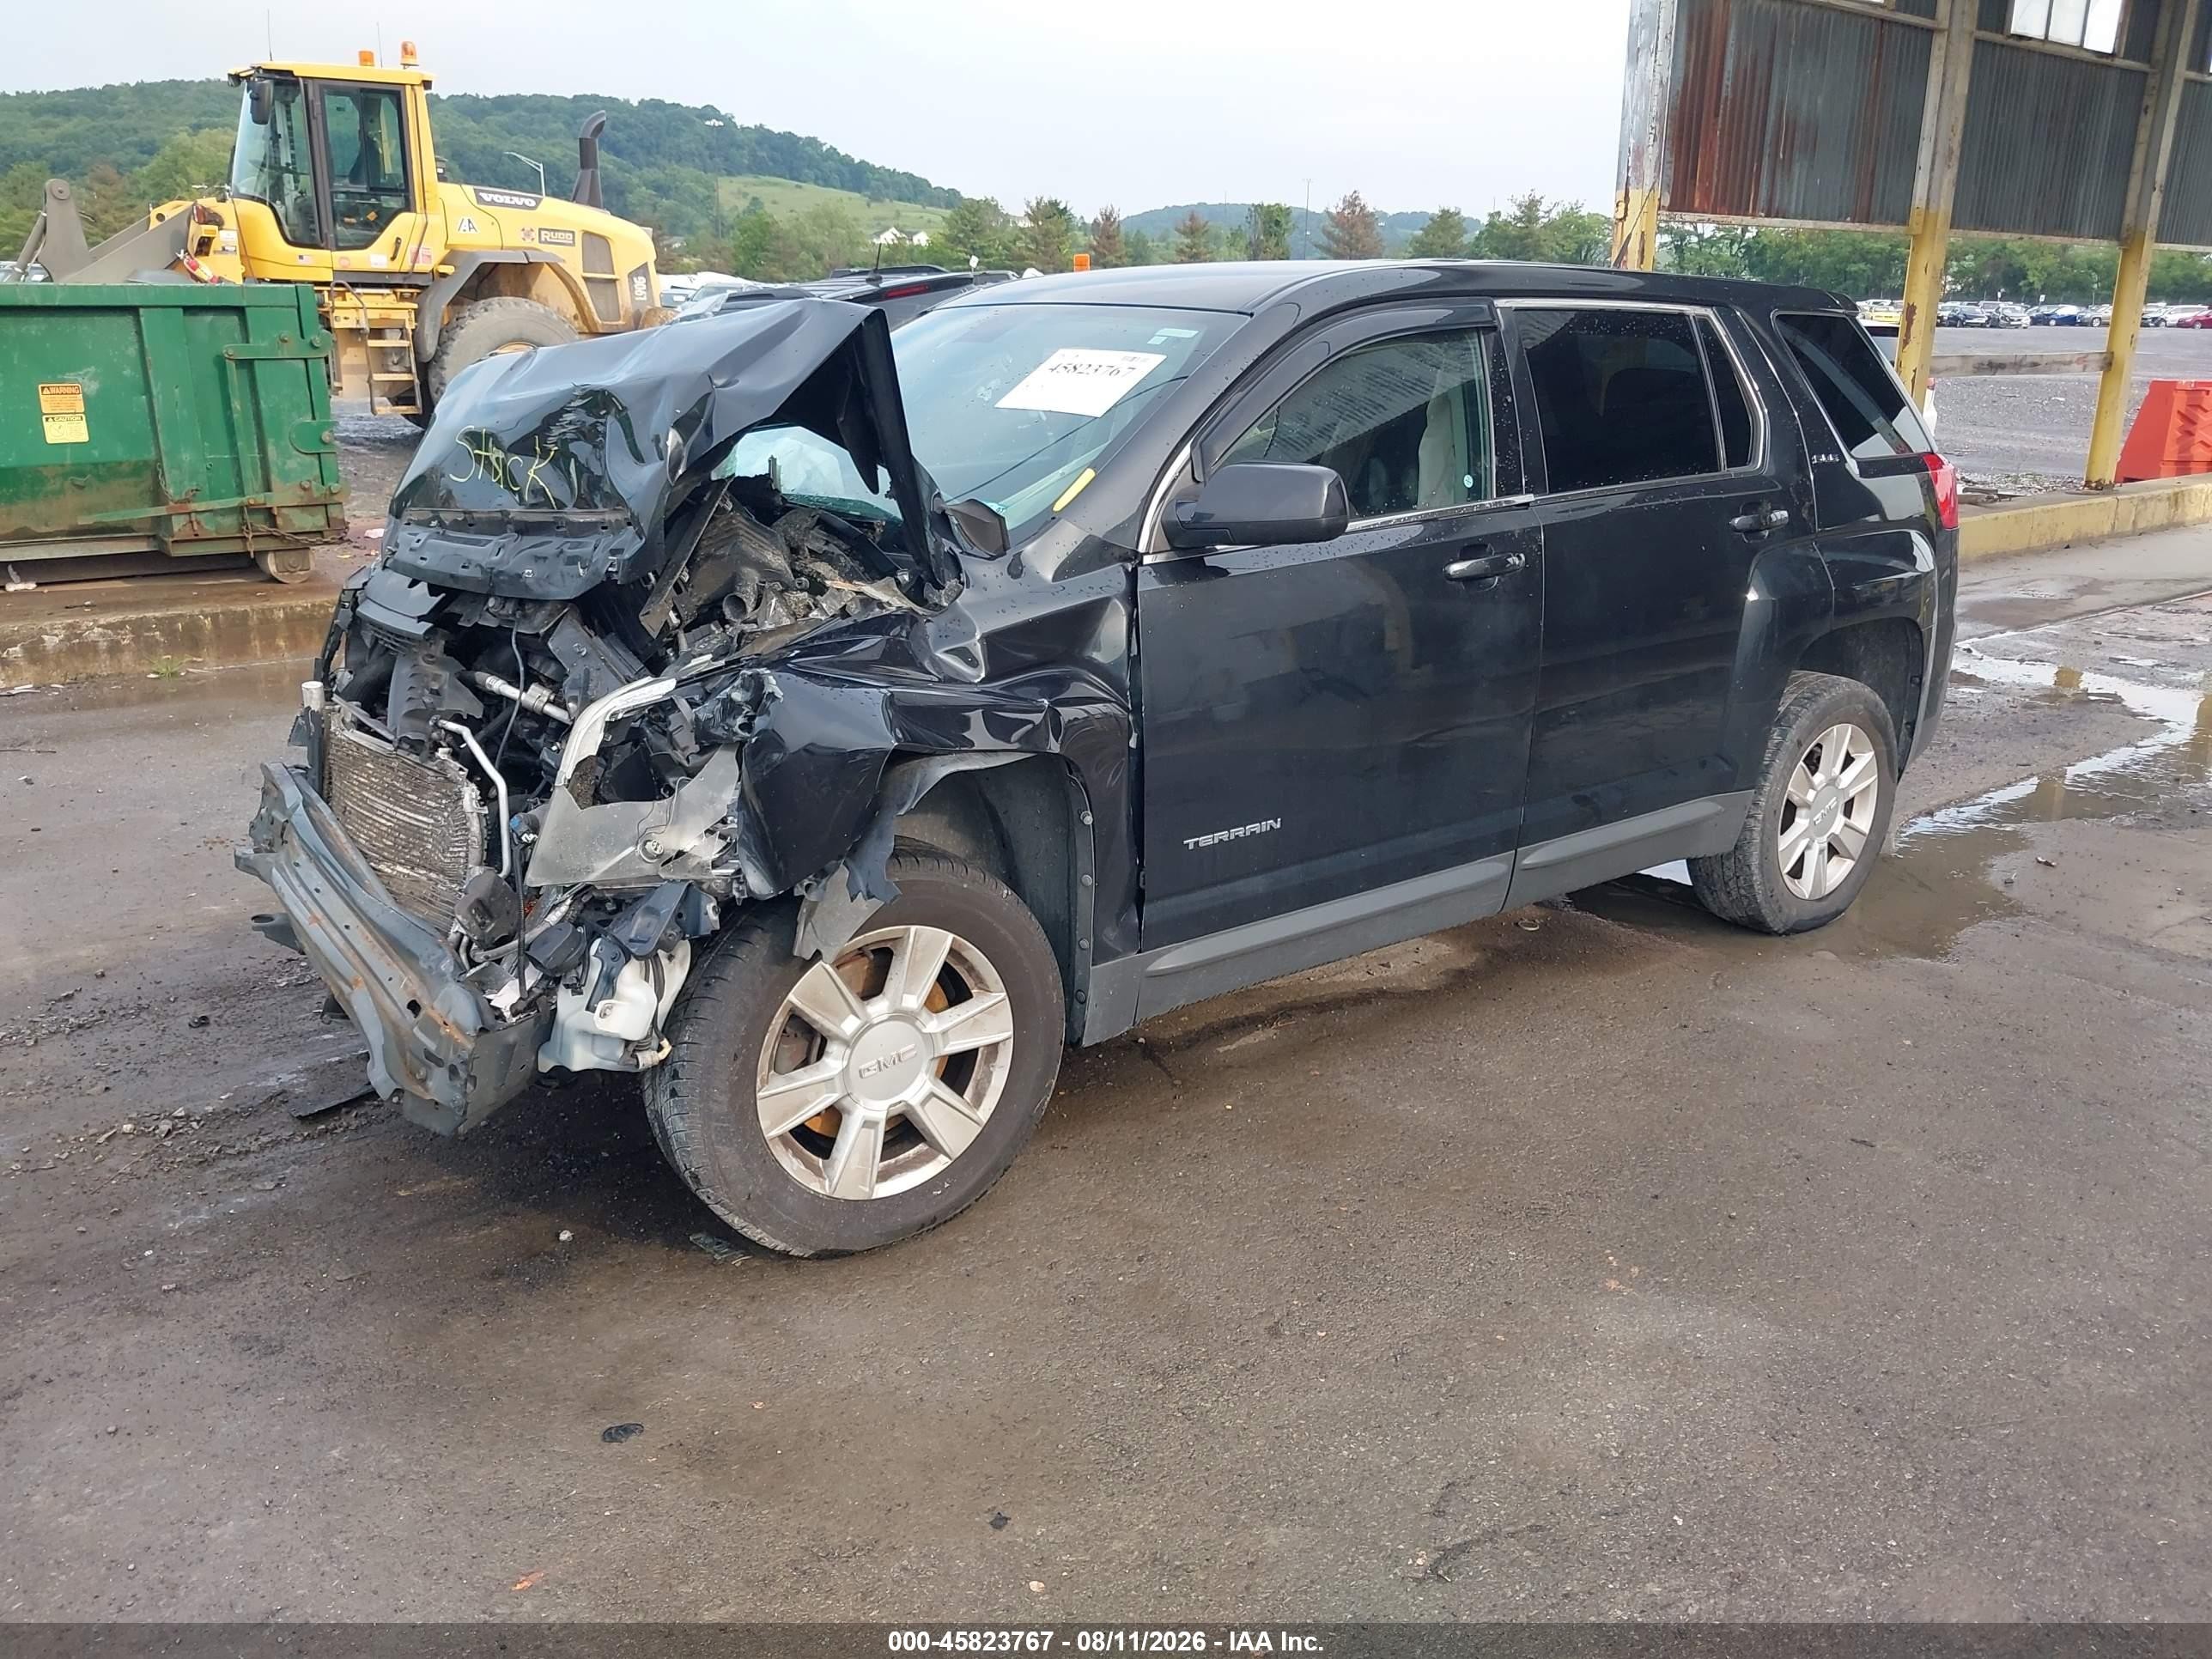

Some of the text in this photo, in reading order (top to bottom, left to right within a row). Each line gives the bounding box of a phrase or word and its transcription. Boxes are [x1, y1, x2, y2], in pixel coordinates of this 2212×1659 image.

[478, 192, 537, 207] VOLVO
[632, 276, 647, 301] L90G
[1048, 362, 1137, 378] 45823767
[1182, 817, 1282, 850] TERRAIN
[858, 1043, 917, 1079] GMC
